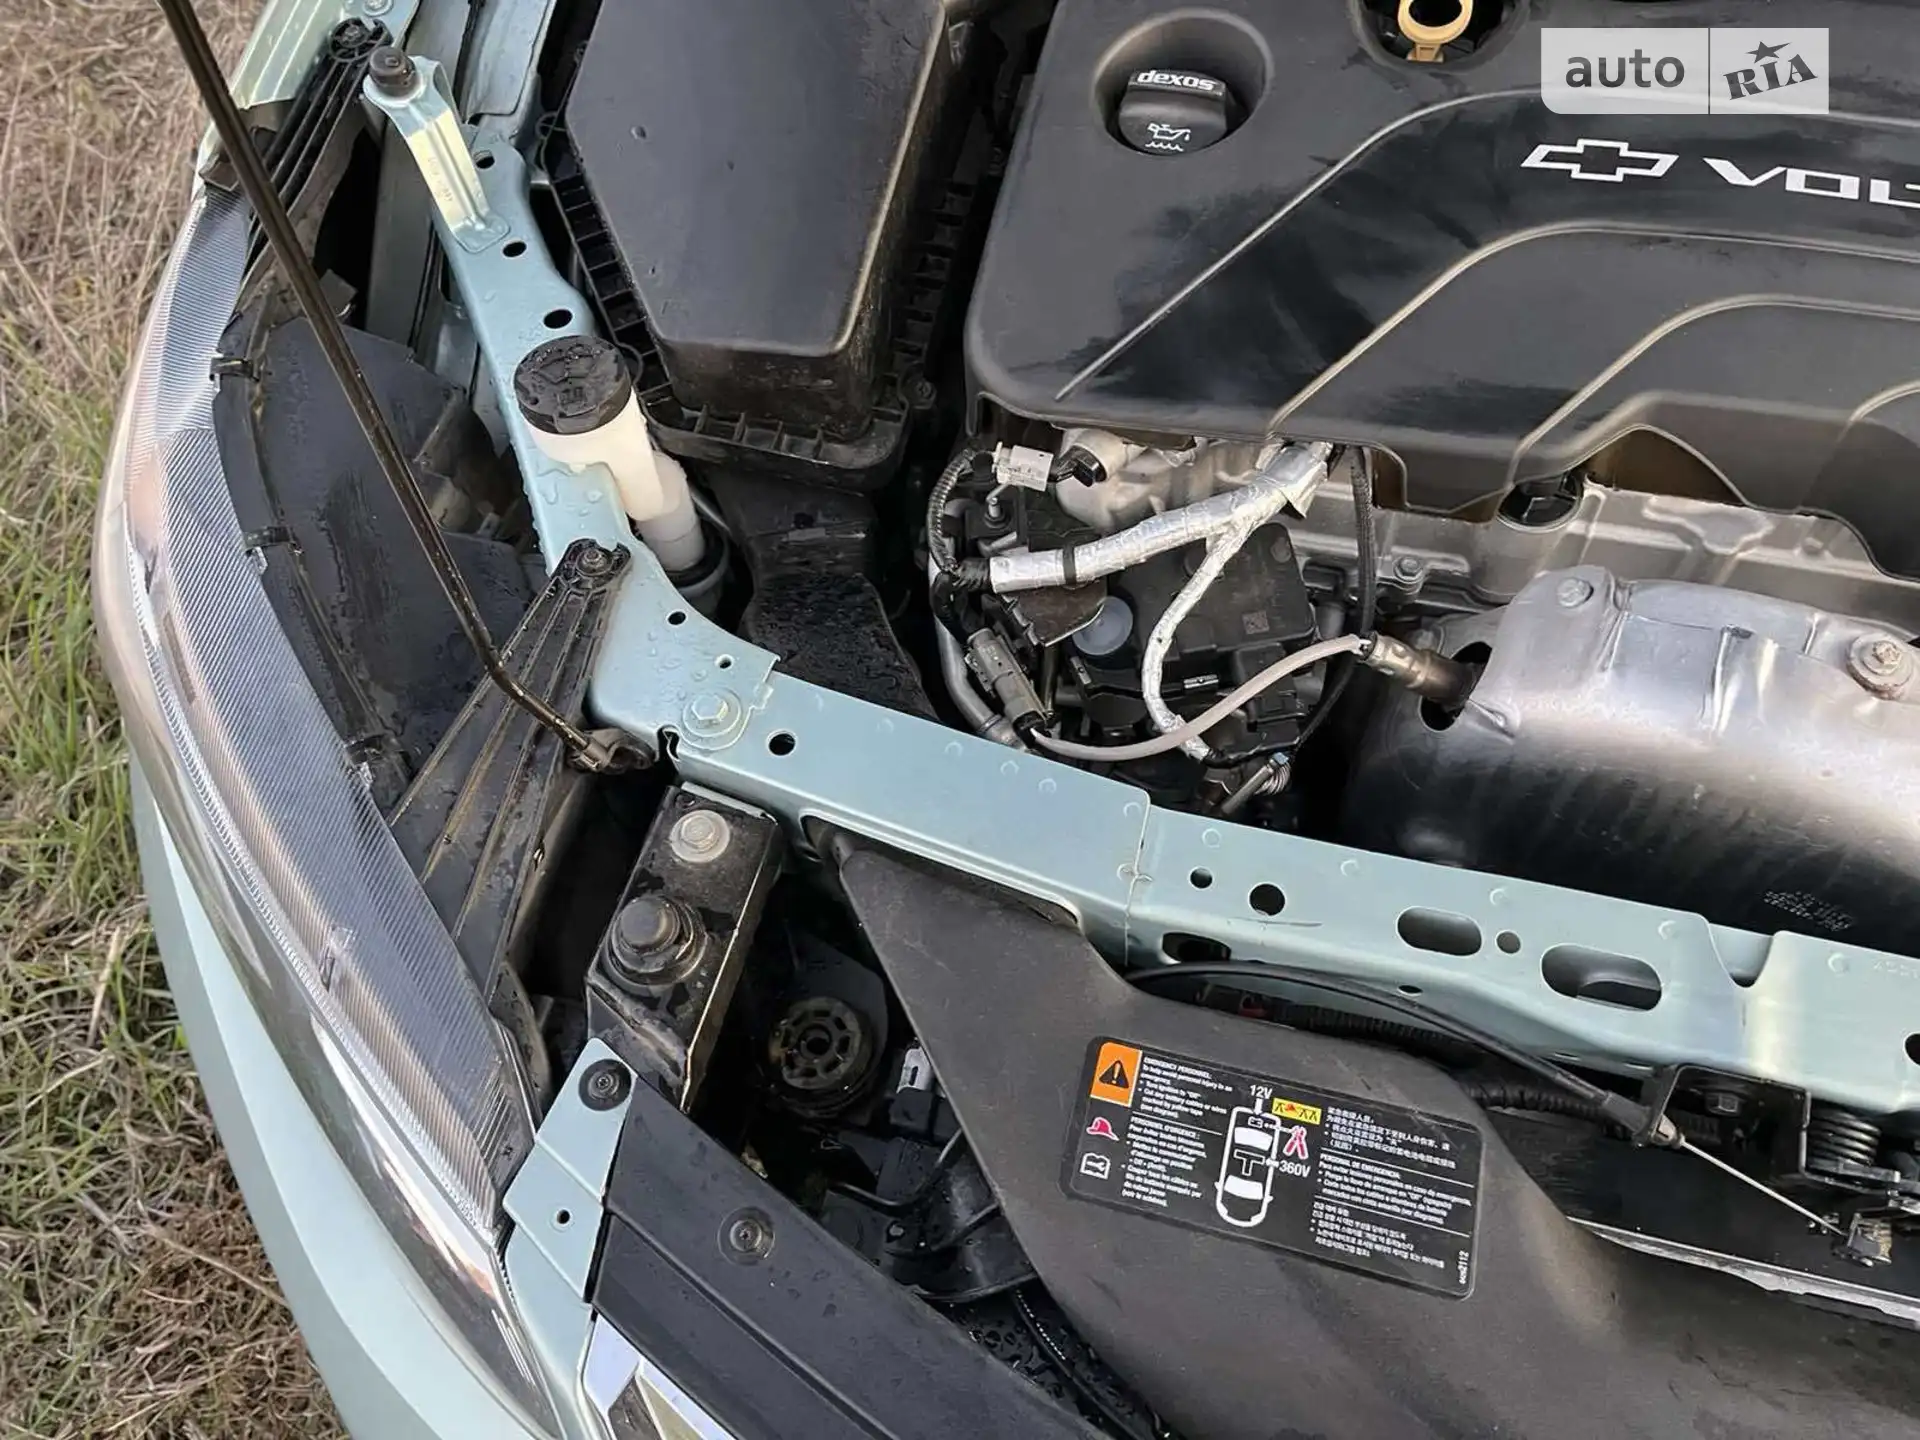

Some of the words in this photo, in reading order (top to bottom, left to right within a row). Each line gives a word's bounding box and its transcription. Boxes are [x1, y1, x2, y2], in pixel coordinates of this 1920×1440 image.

[1138, 69, 1217, 91] dexos
[1703, 157, 1920, 209] VOL
[1250, 1085, 1273, 1099] 12V
[1279, 1162, 1311, 1177] 360V
